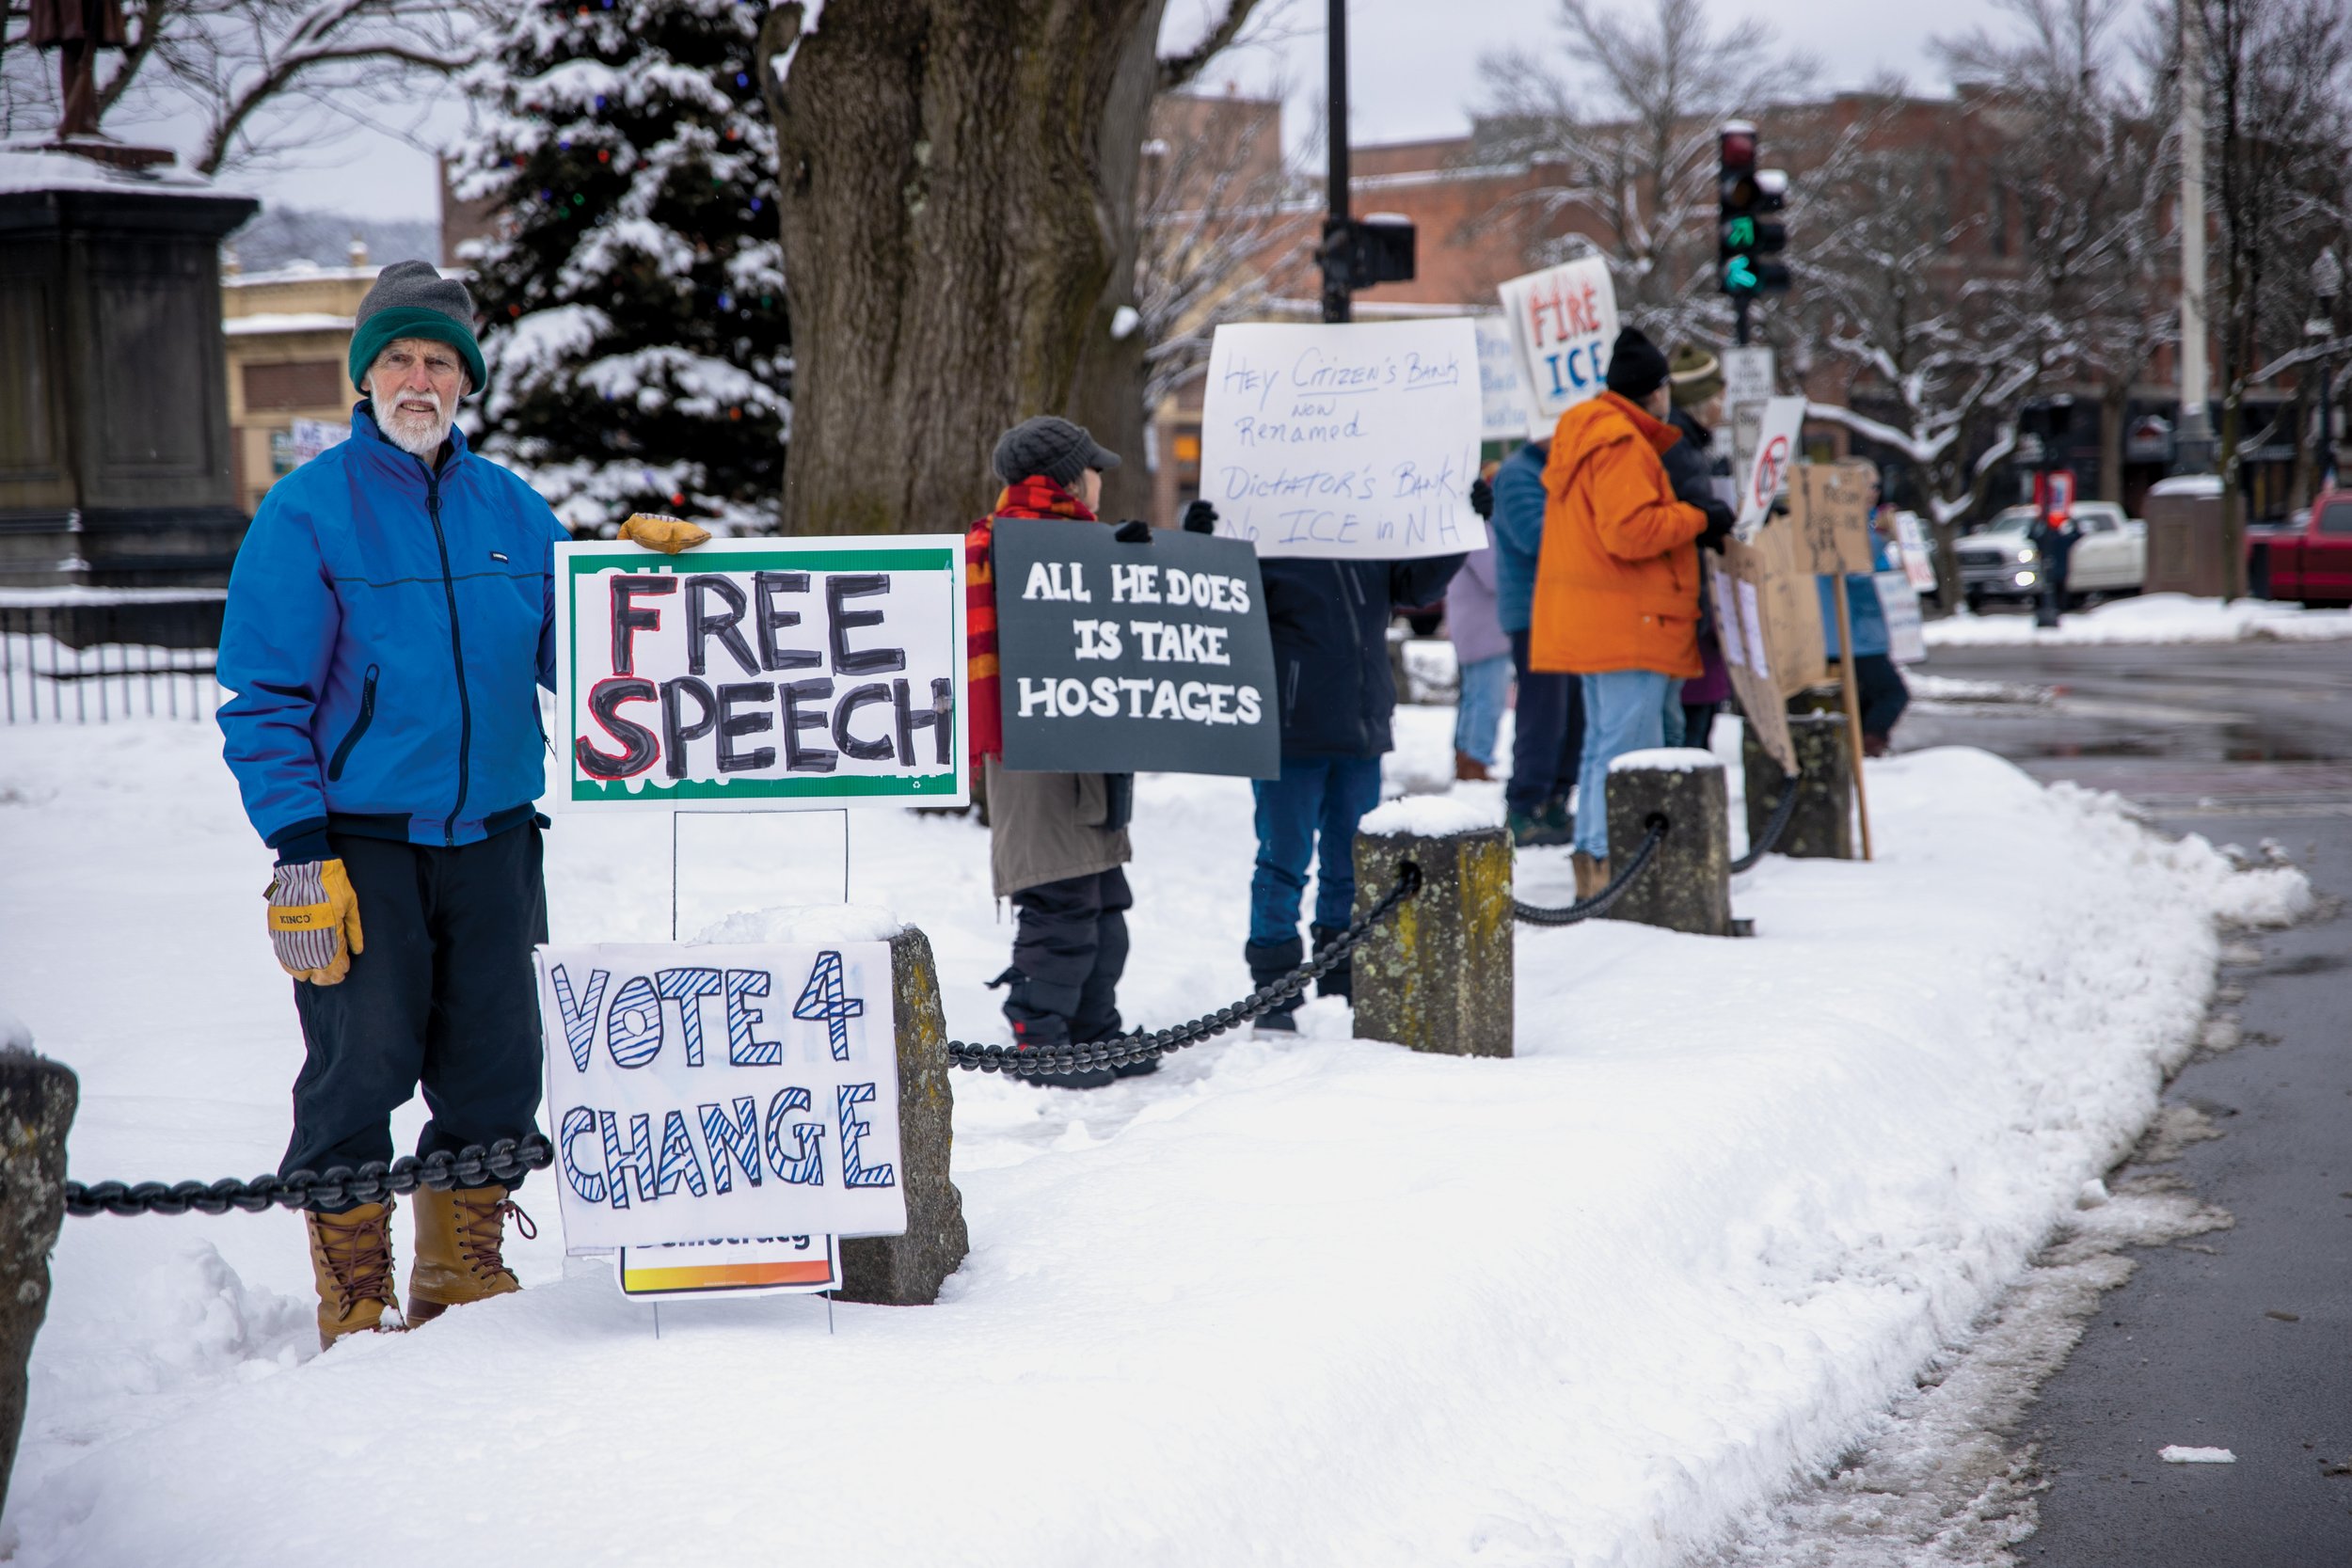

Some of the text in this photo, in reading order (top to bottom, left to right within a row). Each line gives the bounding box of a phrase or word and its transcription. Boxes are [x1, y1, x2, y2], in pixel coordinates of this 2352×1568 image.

[1529, 277, 1601, 347] FIRE
[1545, 341, 1607, 397] ICE
[1279, 509, 1359, 544] ICE
[1022, 562, 1250, 613] ALL HE DOES
[610, 571, 906, 676] FREE
[1073, 618, 1231, 666] IS TAKE
[576, 676, 953, 780] SPEECH
[1017, 676, 1263, 726] HOSTAGES
[279, 914, 310, 924] KINCO
[551, 951, 864, 1072] VOTE 4
[561, 1083, 896, 1210] CHANGE
